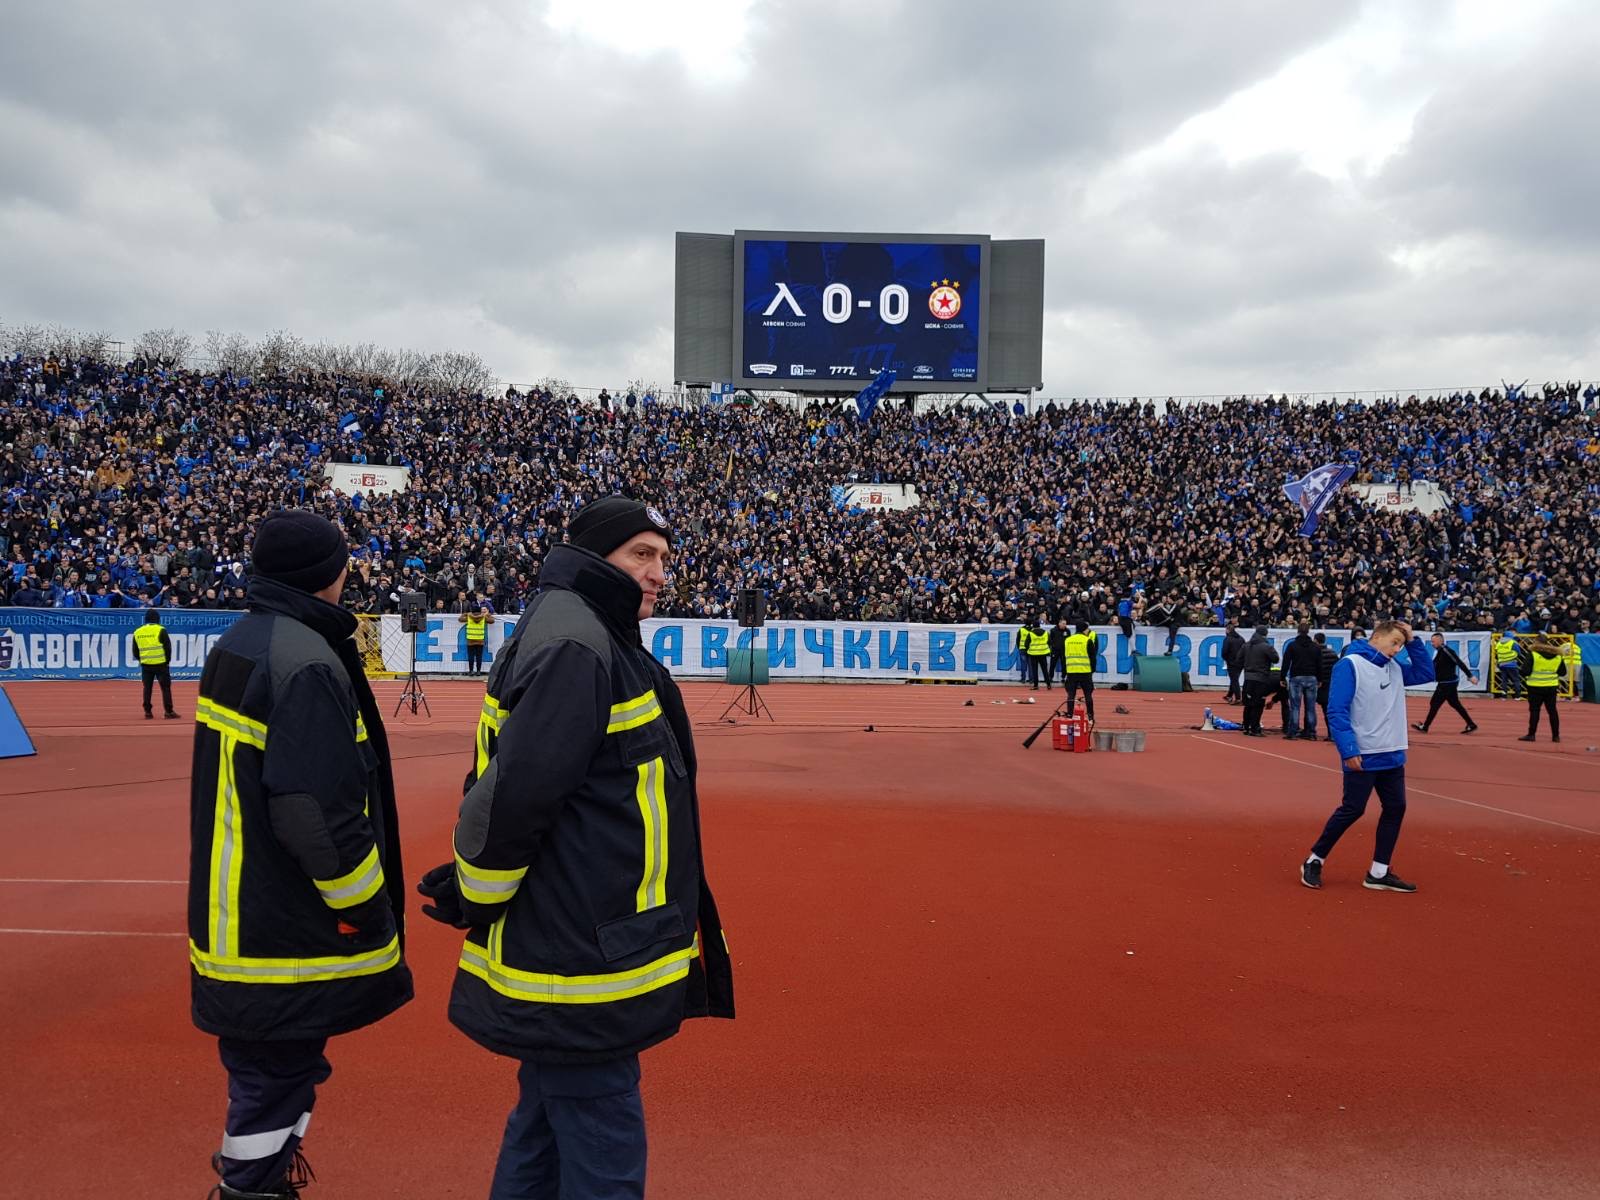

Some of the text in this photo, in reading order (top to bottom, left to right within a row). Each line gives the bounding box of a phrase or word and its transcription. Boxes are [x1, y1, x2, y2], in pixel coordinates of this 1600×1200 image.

[84, 615, 115, 625] КЛУБ
[119, 616, 135, 625] НА
[10, 633, 119, 669] ЛЕВСКИ
